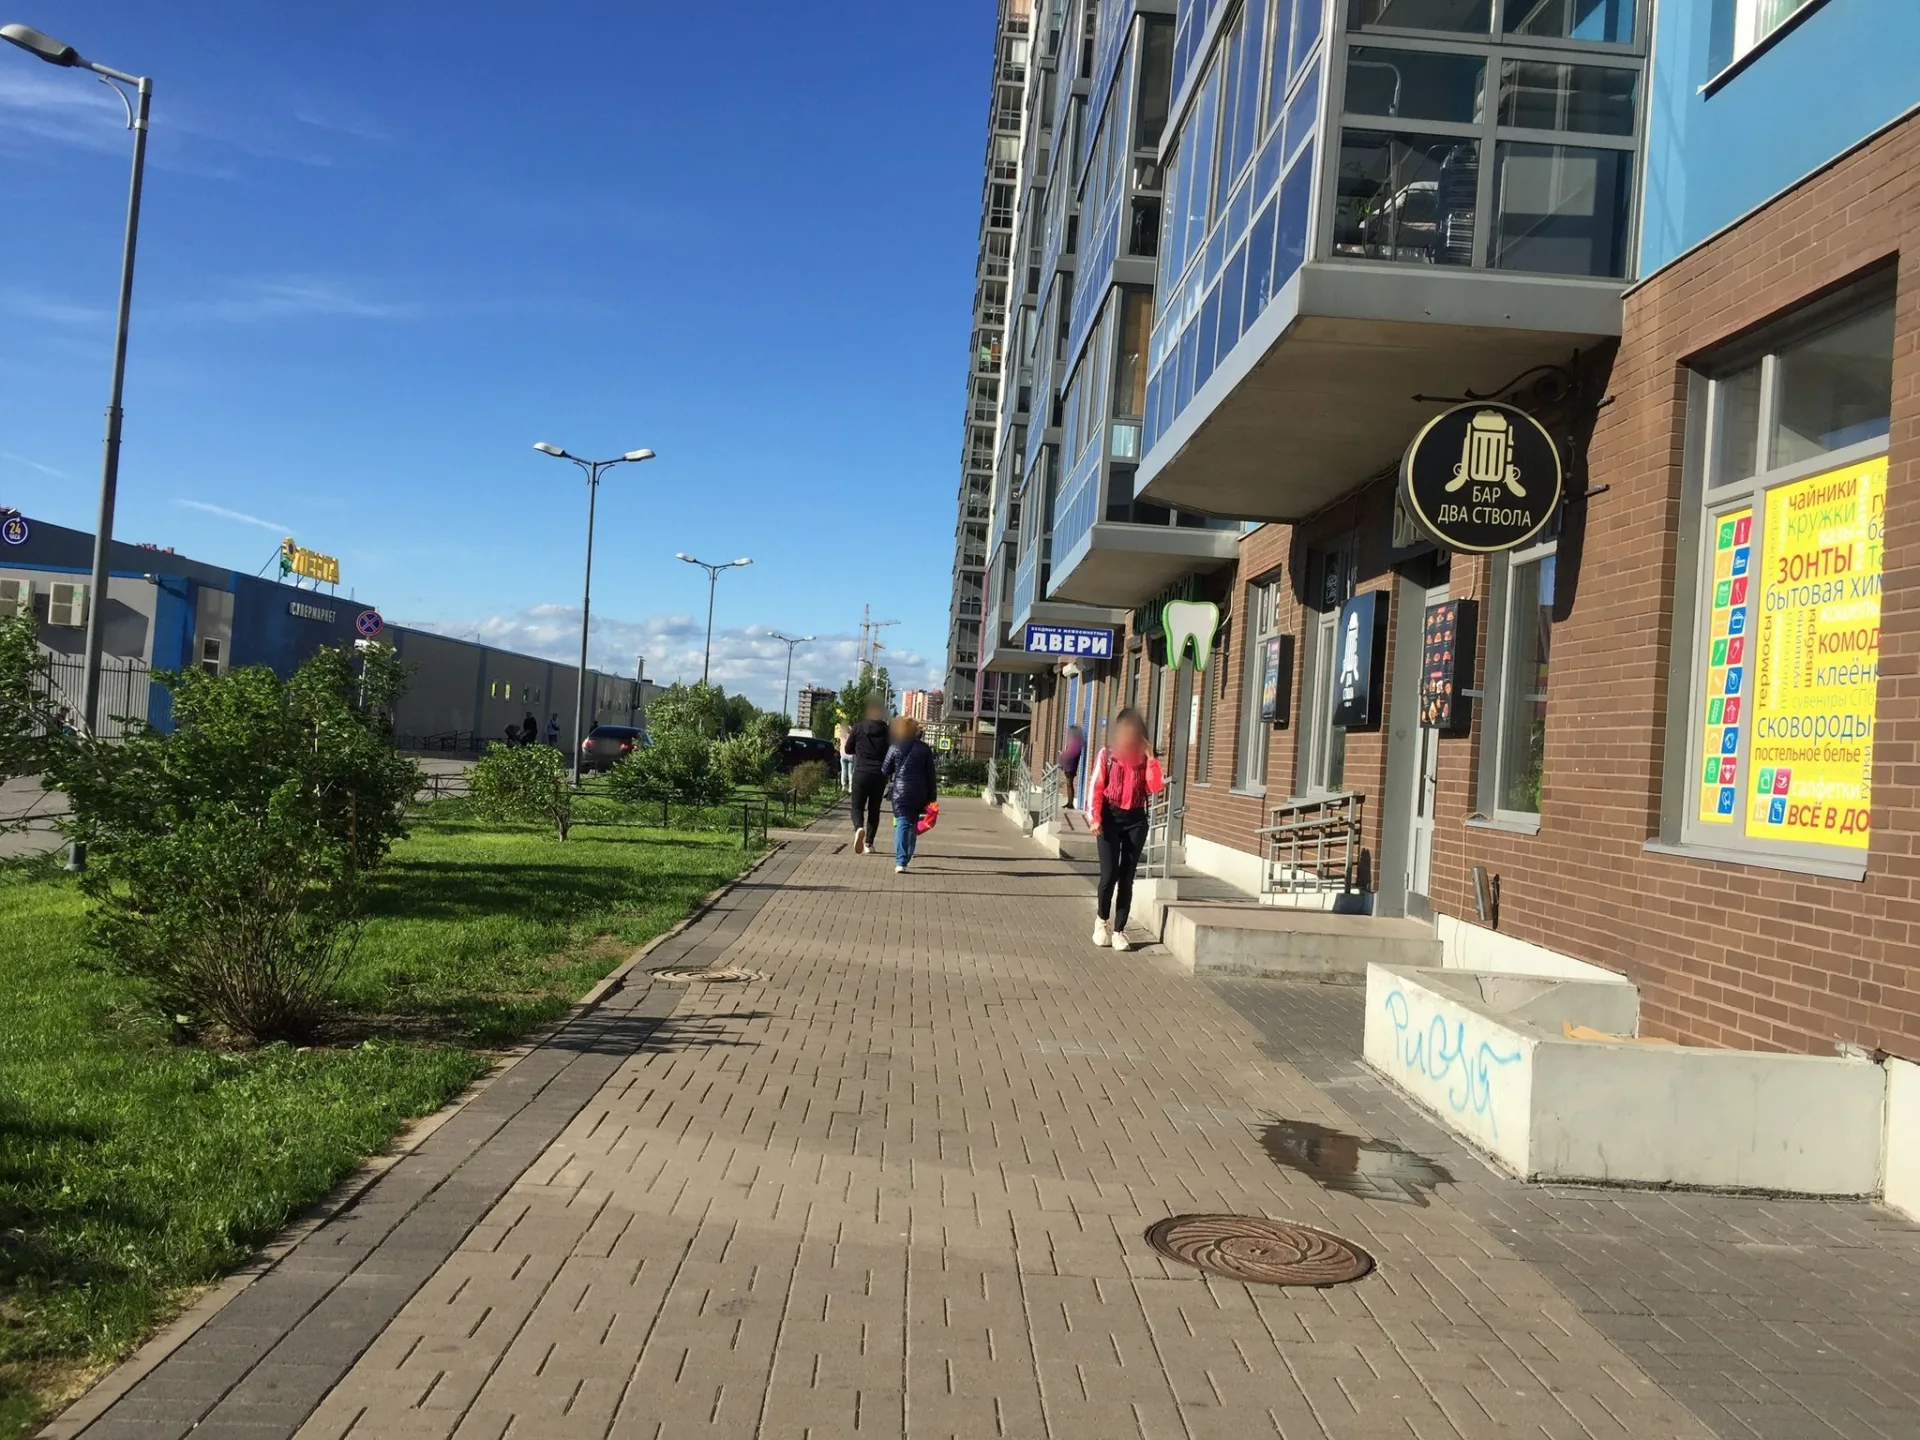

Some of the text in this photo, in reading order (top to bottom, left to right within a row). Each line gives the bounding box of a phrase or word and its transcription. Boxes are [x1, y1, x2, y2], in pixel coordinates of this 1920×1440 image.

[1472, 486, 1501, 504] БАР
[1789, 478, 1857, 511] чайники
[9, 522, 21, 534] 24
[1437, 504, 1532, 527] ДВА СТВОЛА
[1788, 501, 1856, 543] кружки
[1766, 579, 1844, 612] бытовая
[289, 601, 337, 624] СУПЕРМАРКЕТ
[1029, 632, 1108, 655] ДВЕРИ
[1793, 610, 1803, 689] кувшины
[1804, 608, 1817, 688] швабры
[1759, 615, 1772, 710] термосы
[1792, 693, 1847, 710] сувениры
[1758, 714, 1871, 746] сковороды
[1755, 742, 1861, 763] постельное белье
[1791, 775, 1861, 801] салфетки
[1787, 801, 1871, 835] ВСЁ В ДО
